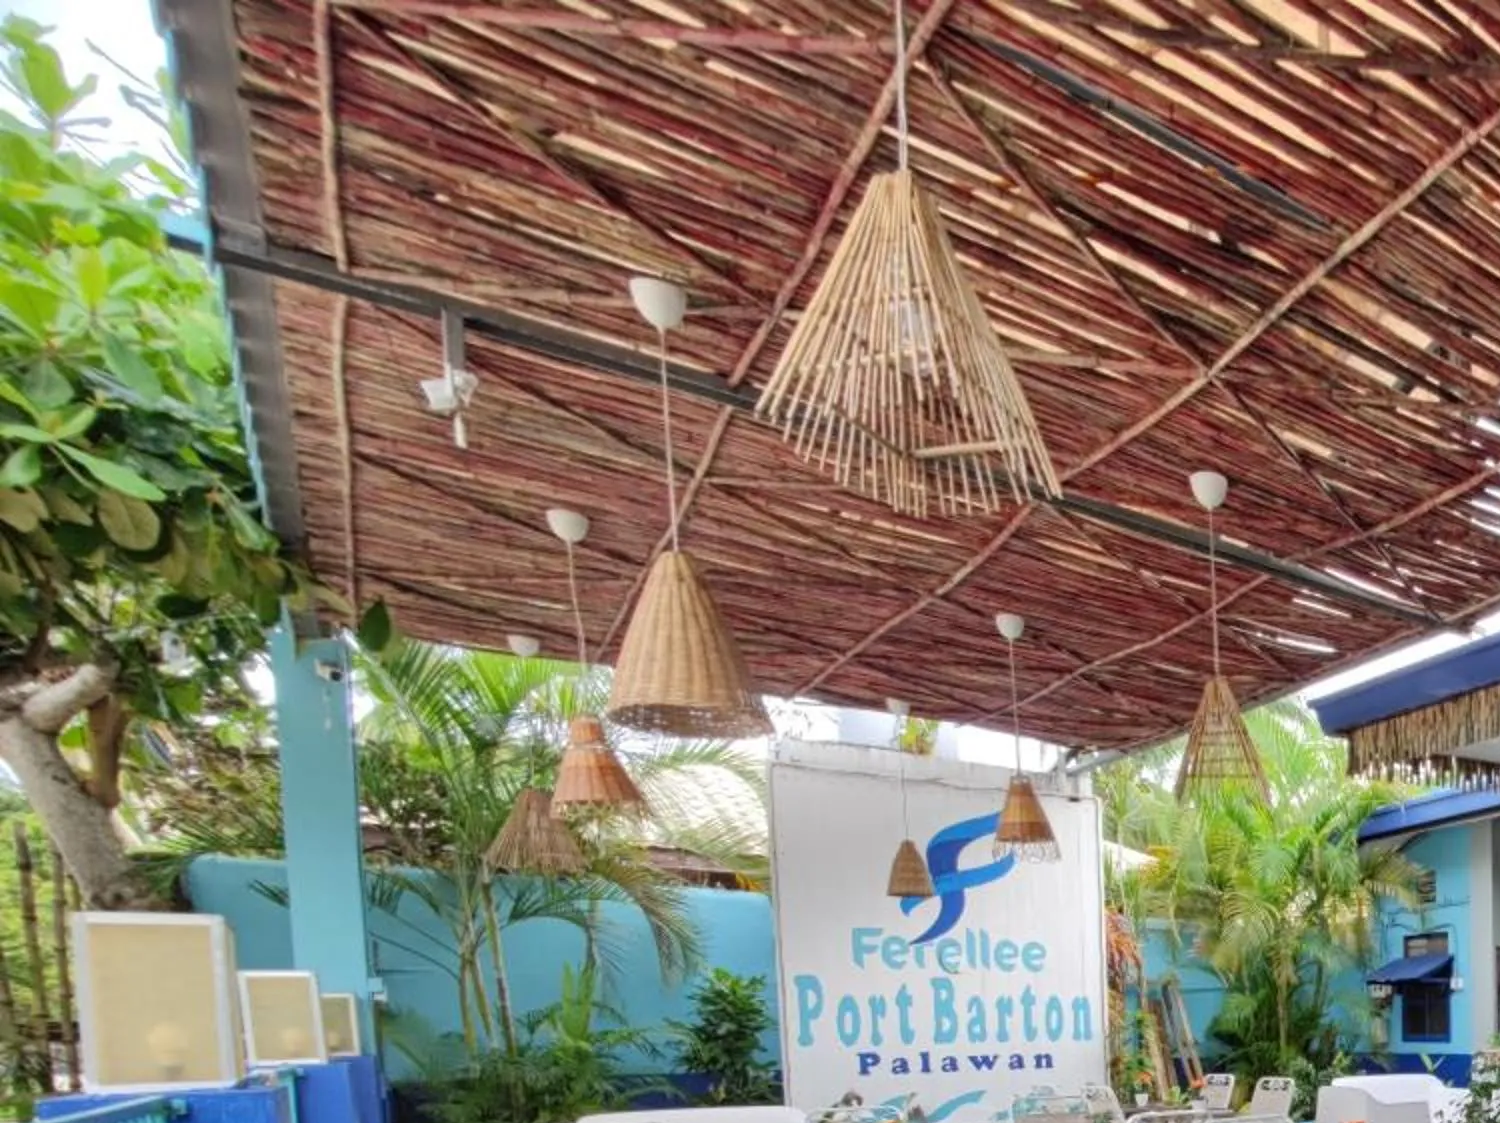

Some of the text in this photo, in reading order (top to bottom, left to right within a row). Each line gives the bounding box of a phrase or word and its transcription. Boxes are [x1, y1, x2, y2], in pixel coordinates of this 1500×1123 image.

[791, 974, 1093, 1047] Port Barton
[856, 1051, 1054, 1076] Palawan
